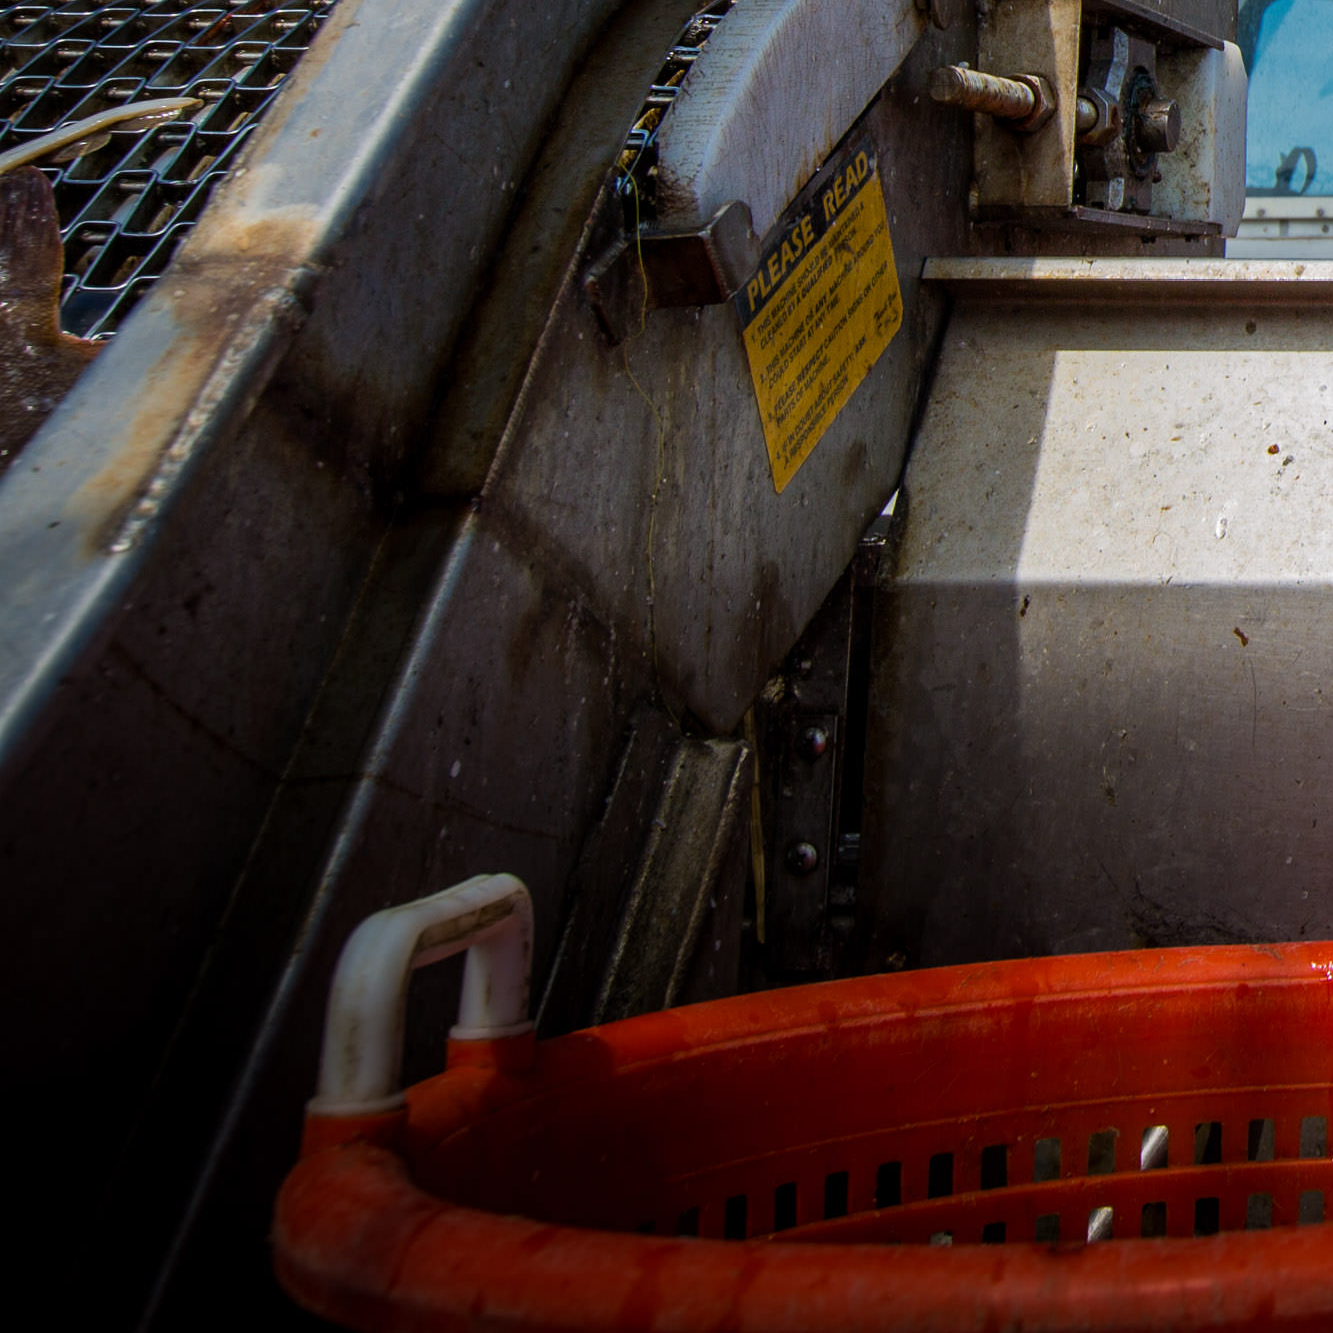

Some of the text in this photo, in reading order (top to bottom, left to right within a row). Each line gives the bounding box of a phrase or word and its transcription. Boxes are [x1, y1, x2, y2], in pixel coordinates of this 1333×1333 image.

[747, 150, 868, 312] PLEASE READ
[757, 314, 771, 338] THIS
[771, 283, 796, 321] MACHINE
[796, 254, 820, 289] SHOULD
[820, 244, 827, 260] BE
[828, 205, 859, 249] MAINTAINED
[760, 310, 787, 351] CLEANED
[786, 301, 795, 317] BY
[800, 253, 832, 300] QUALIFIED
[765, 353, 779, 377] THIS
[779, 321, 804, 359] MACHINE
[814, 292, 827, 314] ANY
[768, 357, 789, 390] COULD
[789, 335, 806, 364] START
[806, 325, 814, 340] AT
[814, 310, 825, 330] ANY
[773, 380, 796, 415] PLEASE
[796, 343, 824, 386] RESPECT
[823, 312, 847, 350] CAUTION
[847, 292, 862, 318] SIGNS
[794, 405, 813, 436] DOUBT
[814, 378, 832, 409] ABOUT
[854, 333, 866, 354] ASK
[776, 397, 795, 428] PARTS
[795, 386, 803, 403] OF
[789, 402, 826, 460] RESPONSIBLE
[826, 372, 848, 408] PERSON
